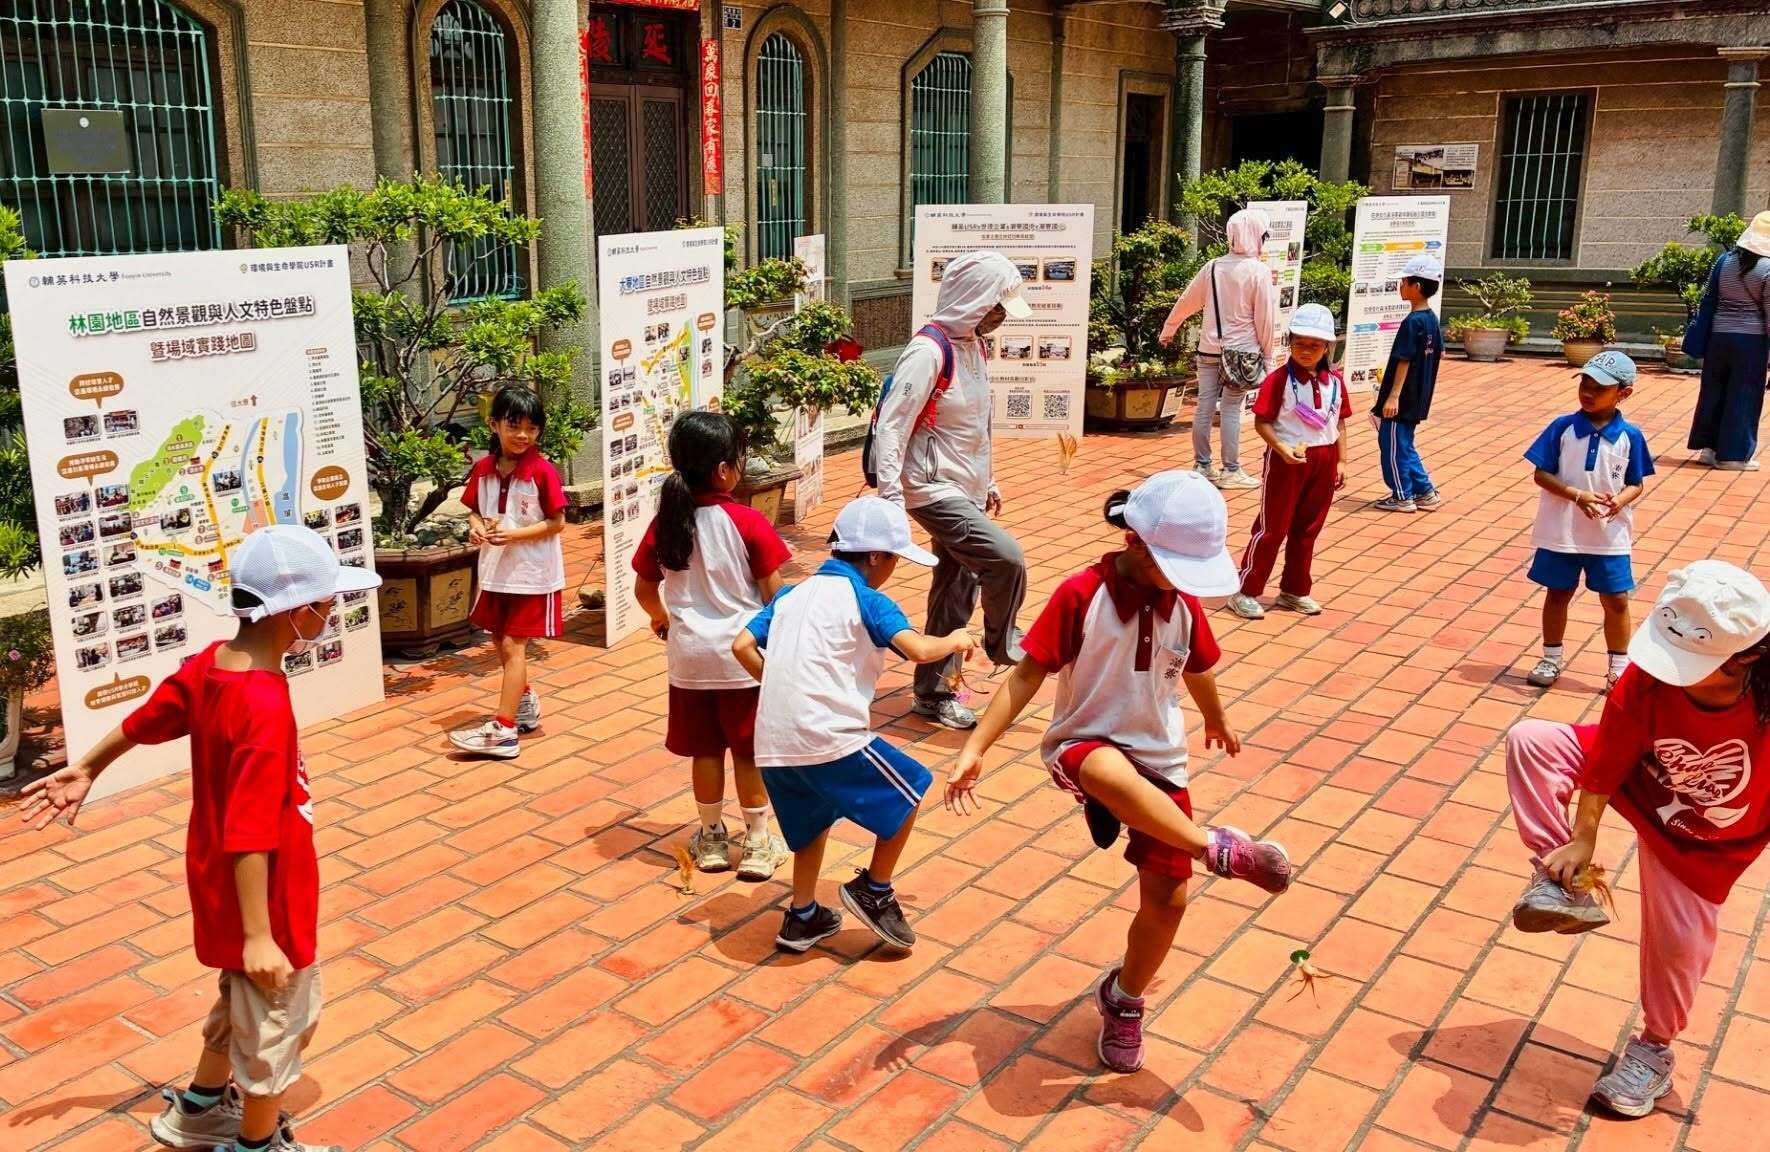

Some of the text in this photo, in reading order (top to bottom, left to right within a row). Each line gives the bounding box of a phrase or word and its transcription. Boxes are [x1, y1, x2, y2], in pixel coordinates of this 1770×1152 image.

[41, 270, 120, 286] 輔英科技大學
[68, 295, 314, 333] 林園地區自然景觀與人文特色盤點
[149, 332, 254, 360] 暨場域實踐地圖
